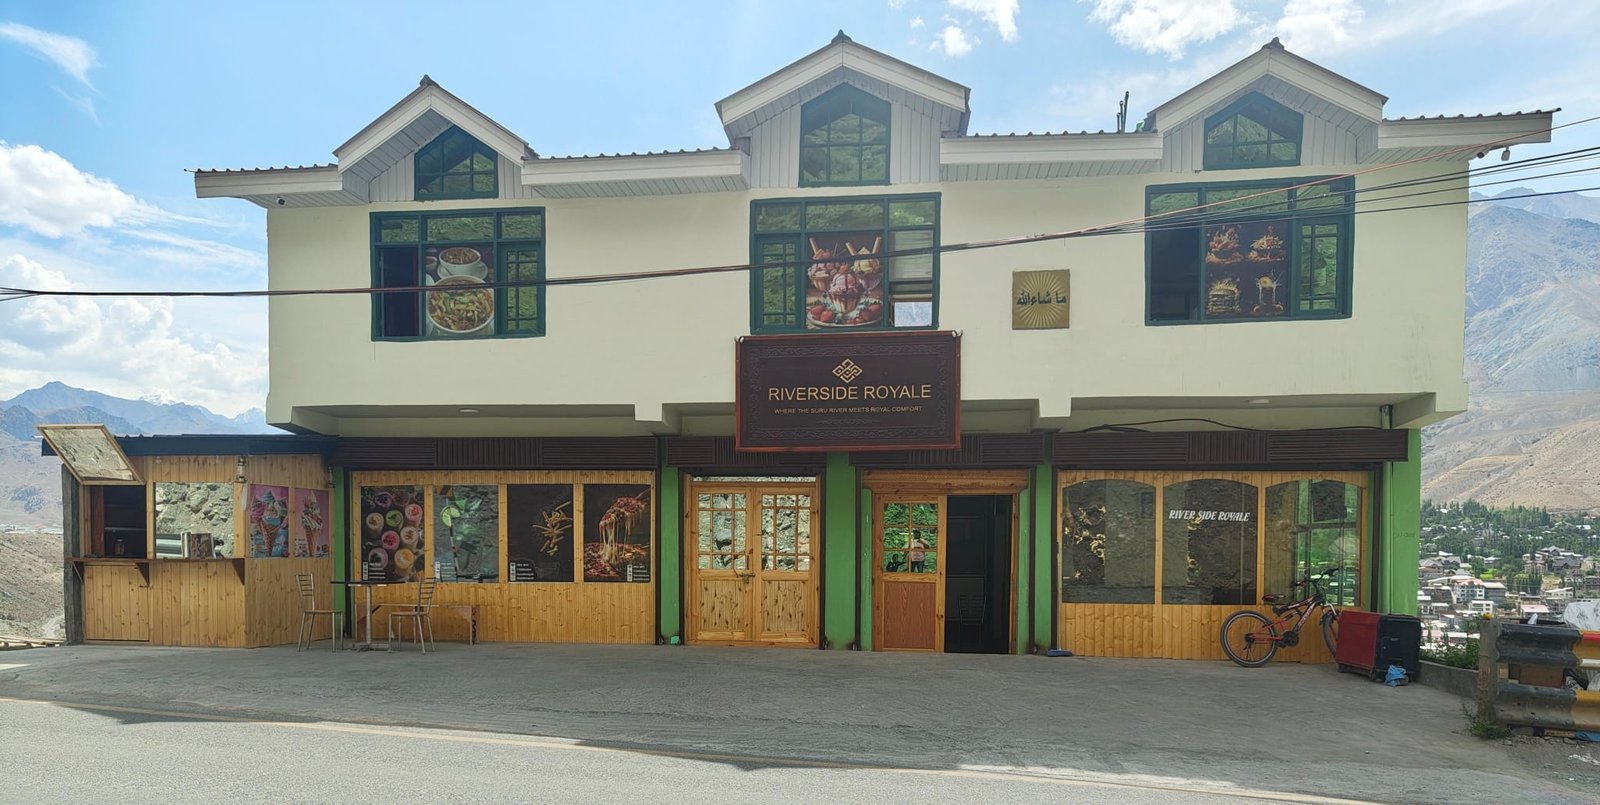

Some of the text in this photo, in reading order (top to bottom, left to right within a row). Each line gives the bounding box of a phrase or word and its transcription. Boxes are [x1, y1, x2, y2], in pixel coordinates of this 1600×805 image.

[768, 384, 932, 401] RIVERSIDE ROYALE
[774, 407, 797, 415] WHERE
[1169, 510, 1250, 522] RIVER SIDE ROYALE
